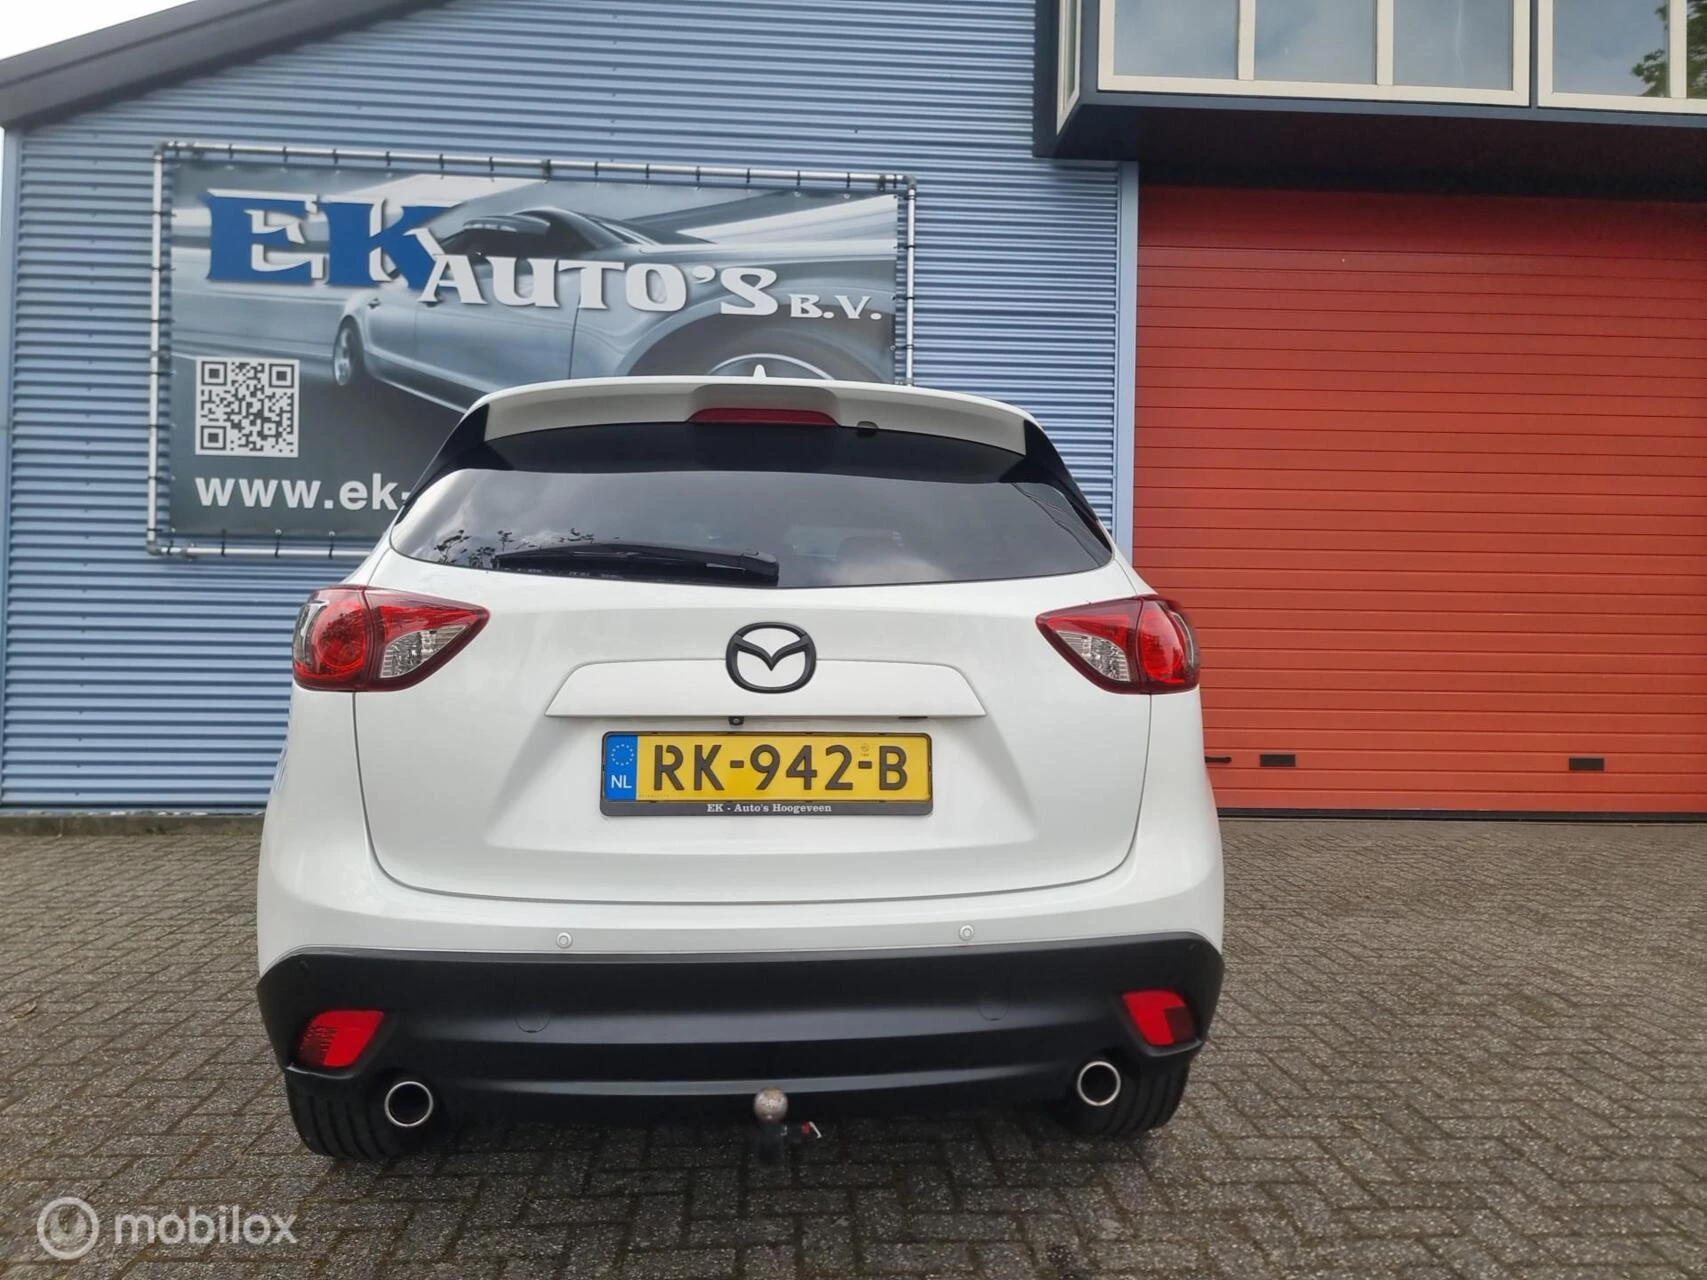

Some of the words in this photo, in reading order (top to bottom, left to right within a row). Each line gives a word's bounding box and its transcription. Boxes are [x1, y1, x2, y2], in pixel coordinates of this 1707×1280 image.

[204, 188, 465, 290] EK
[789, 293, 883, 321] B.V.
[610, 775, 632, 789] NL
[653, 744, 908, 791] RK-942-B
[707, 803, 724, 812] EK
[734, 803, 769, 812] Auto's
[772, 803, 832, 814] Hoogeveen
